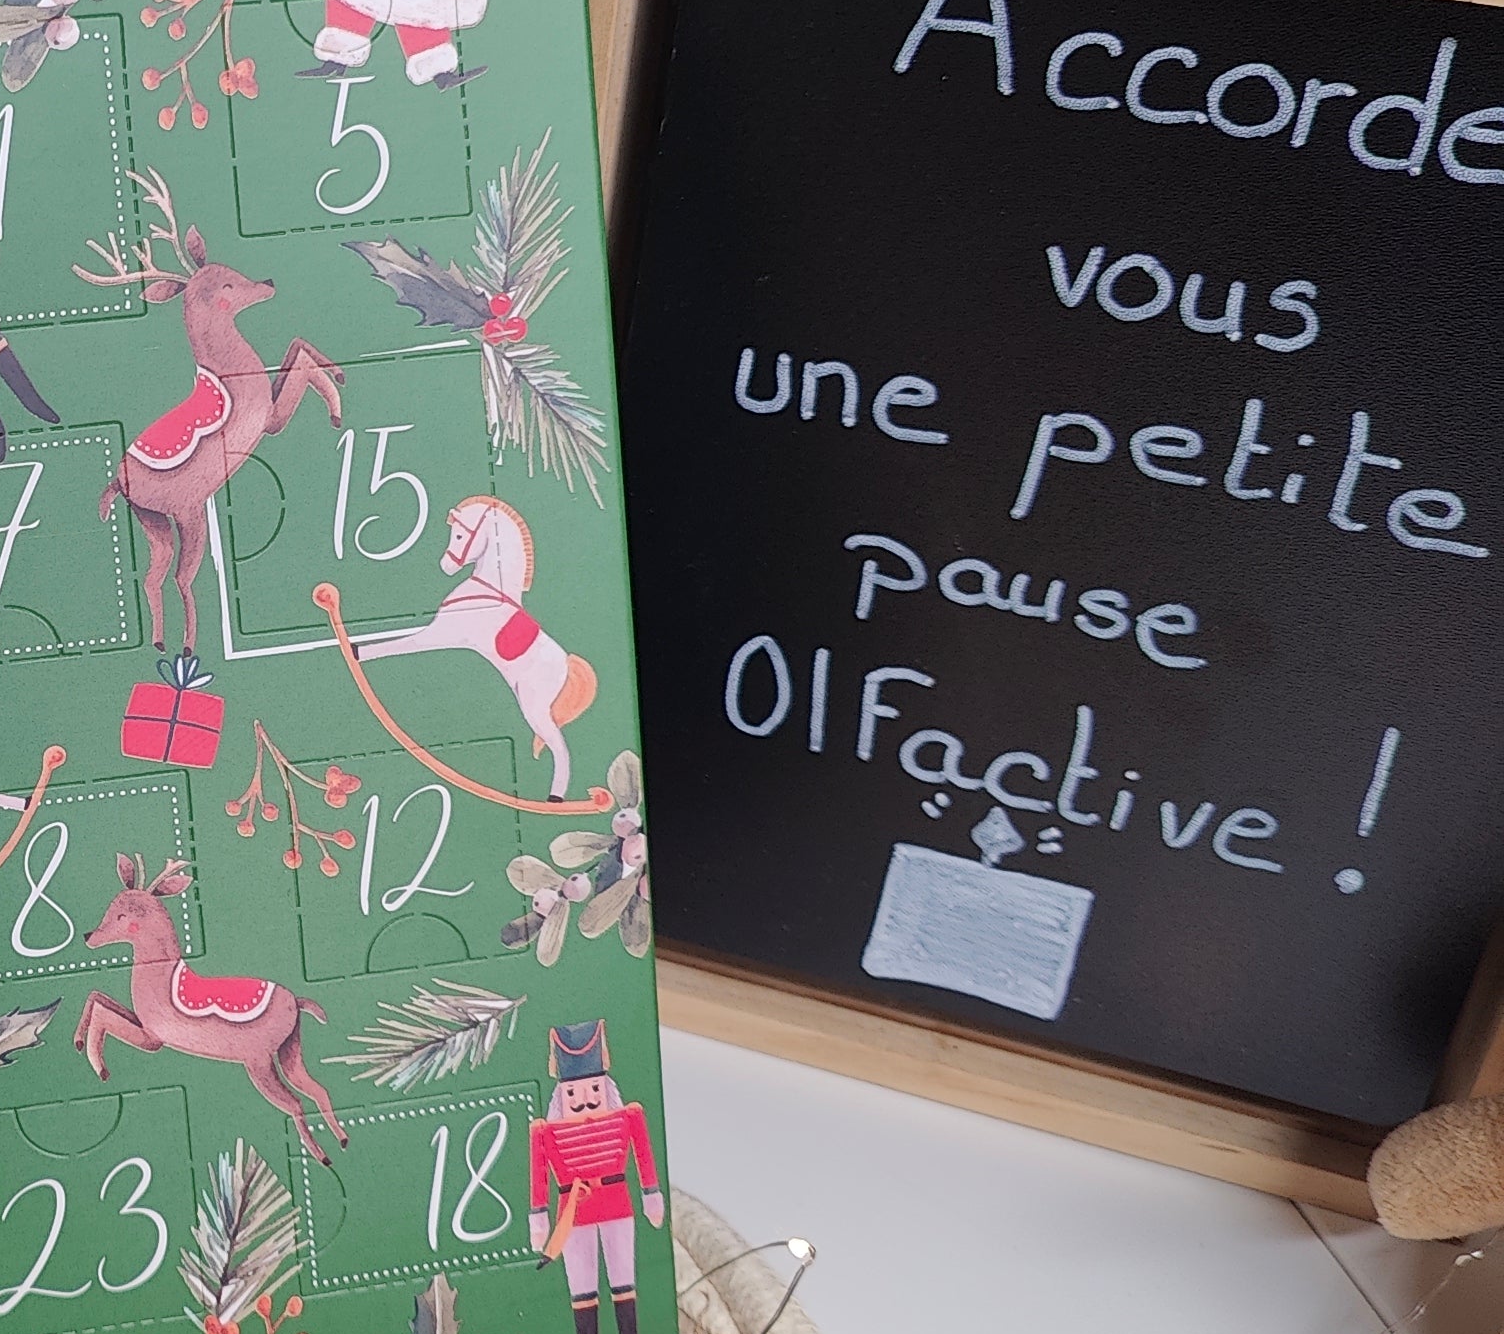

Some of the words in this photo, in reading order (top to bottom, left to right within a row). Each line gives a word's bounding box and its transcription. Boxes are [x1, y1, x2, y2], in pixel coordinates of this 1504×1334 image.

[314, 78, 389, 215] 5
[1046, 246, 1321, 352] vous
[331, 424, 429, 562] 15
[734, 348, 949, 445] une
[1010, 398, 1490, 558] petite
[843, 534, 1207, 669] pause
[358, 784, 474, 916] 12
[1332, 726, 1400, 894] !
[11, 821, 76, 958] 8
[428, 1112, 513, 1252] 18
